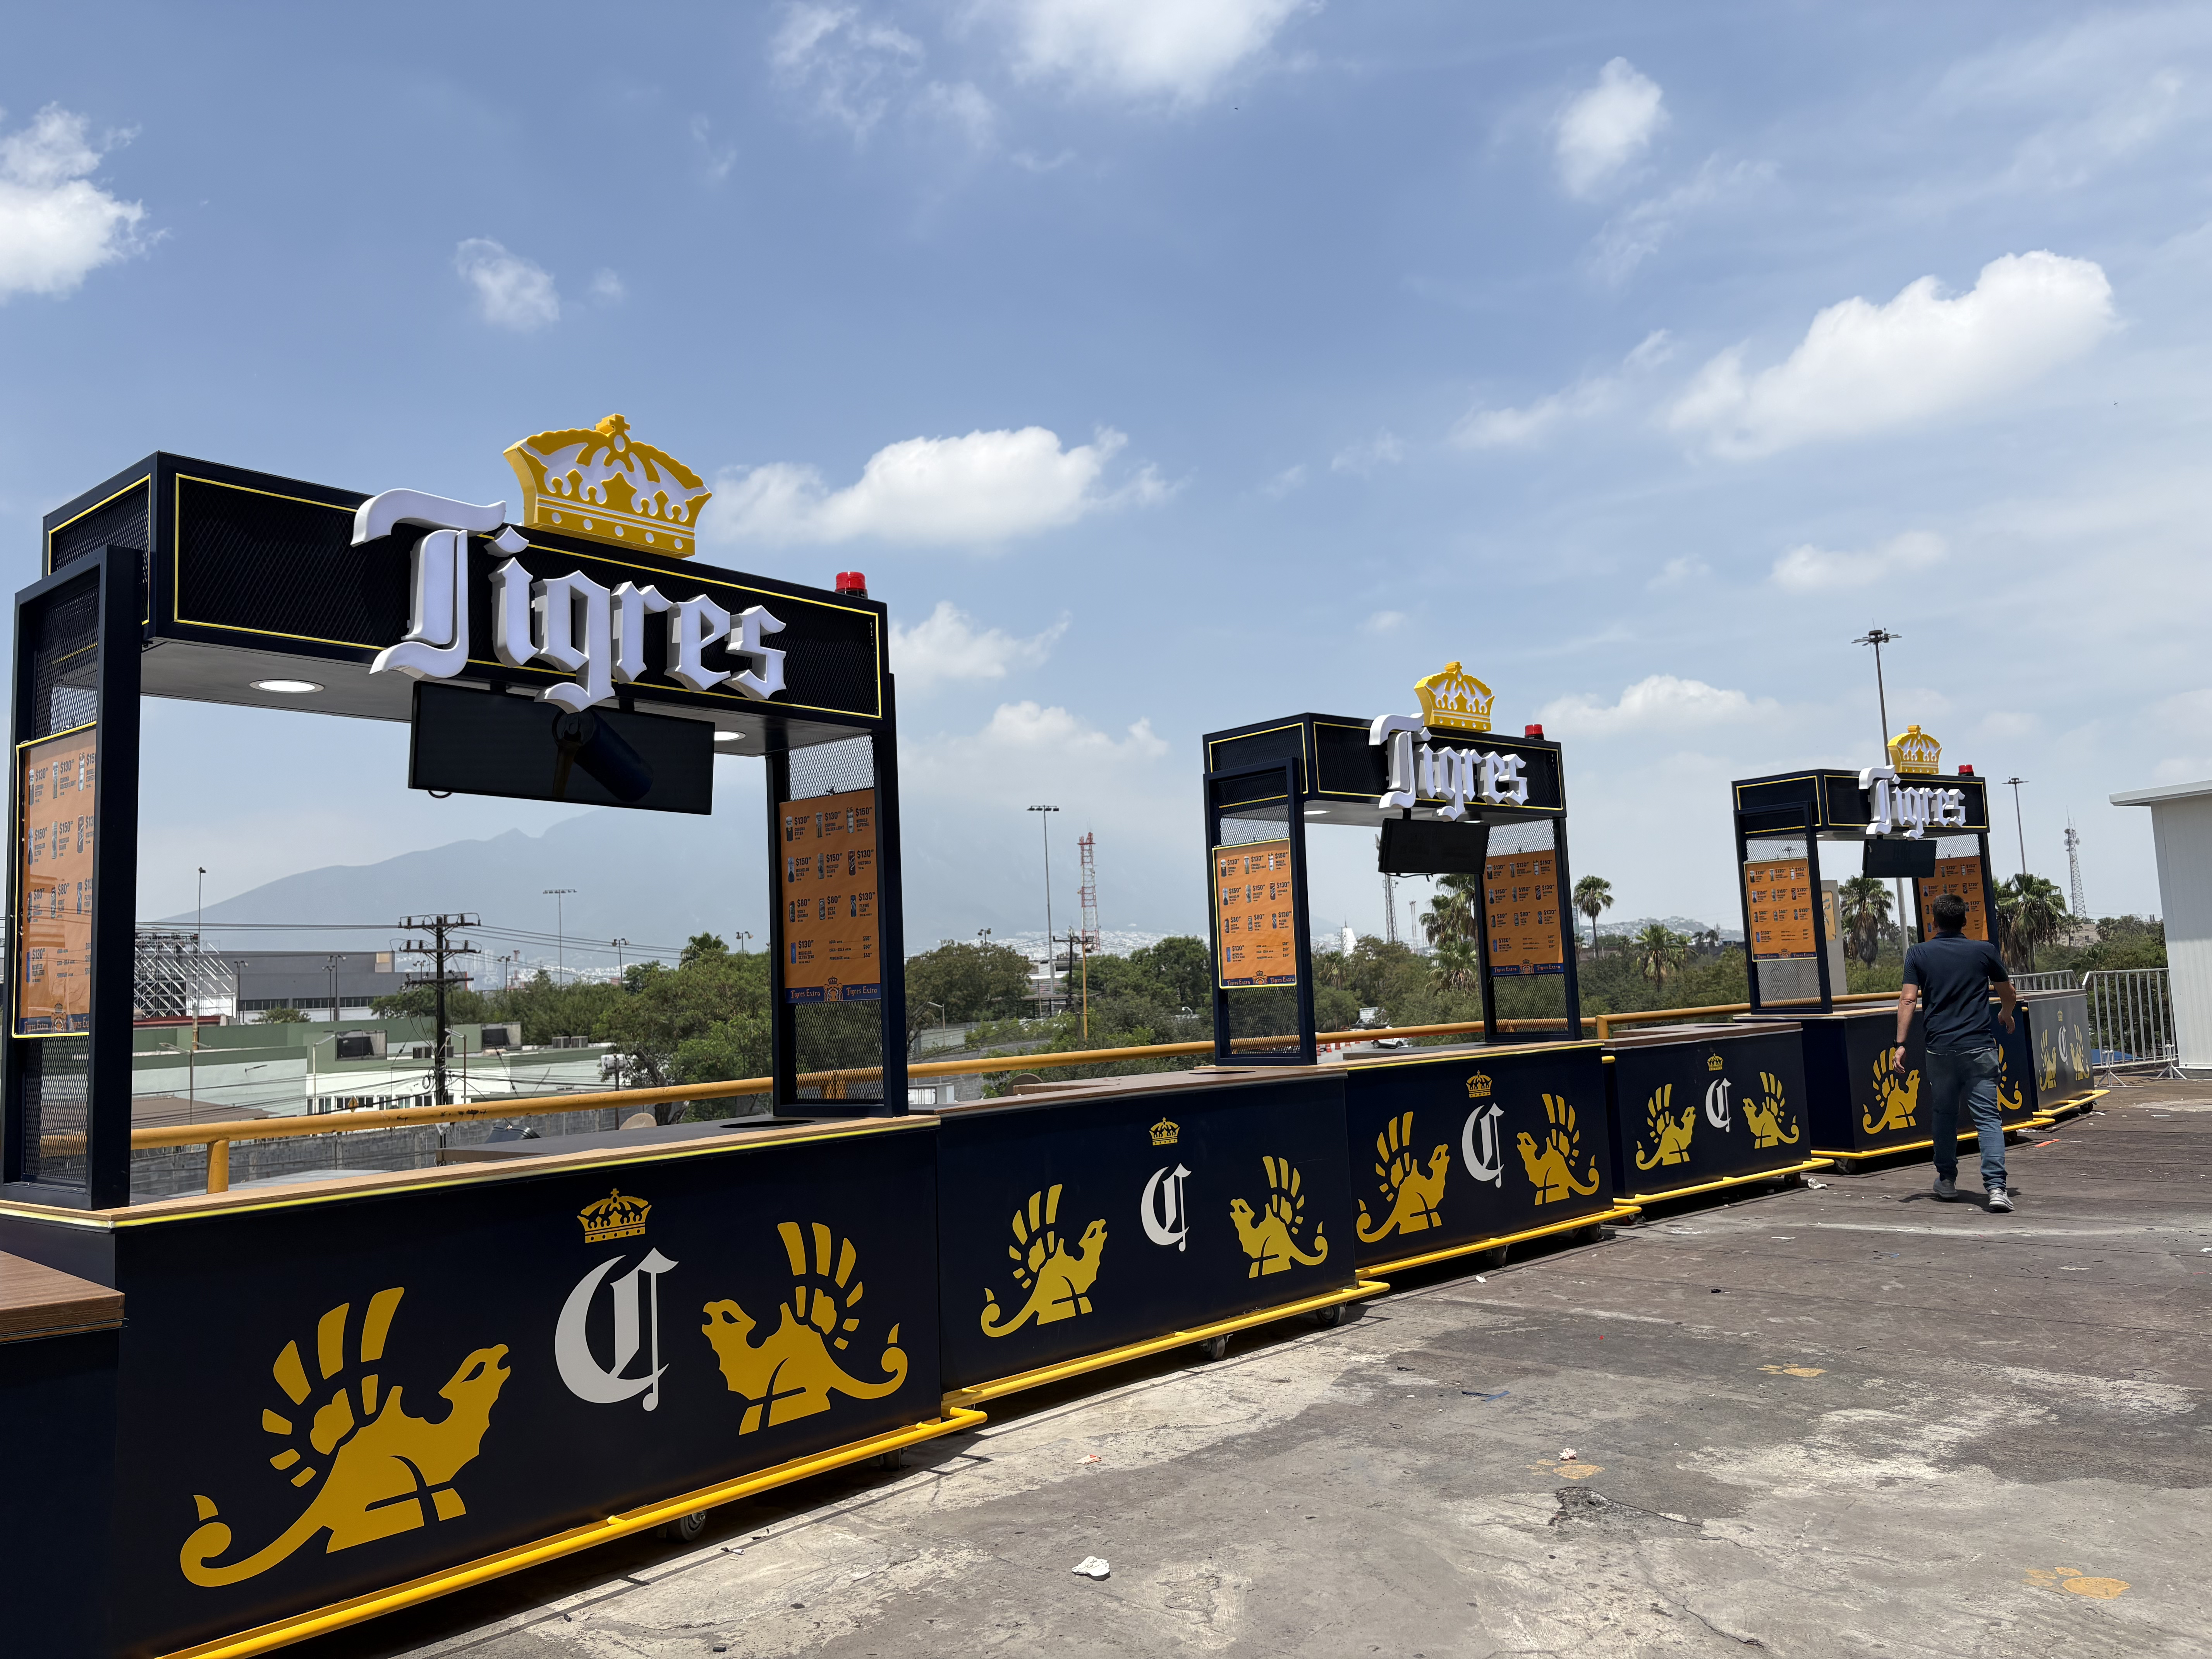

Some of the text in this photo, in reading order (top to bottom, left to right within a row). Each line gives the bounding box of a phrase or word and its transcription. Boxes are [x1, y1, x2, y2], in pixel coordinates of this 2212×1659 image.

[350, 488, 787, 713] Tigres
[1369, 713, 1528, 822] Tigres
[1859, 764, 1966, 840] Tigres
[790, 989, 820, 999] Tigres Extra
[846, 986, 877, 996] Tigres Extra
